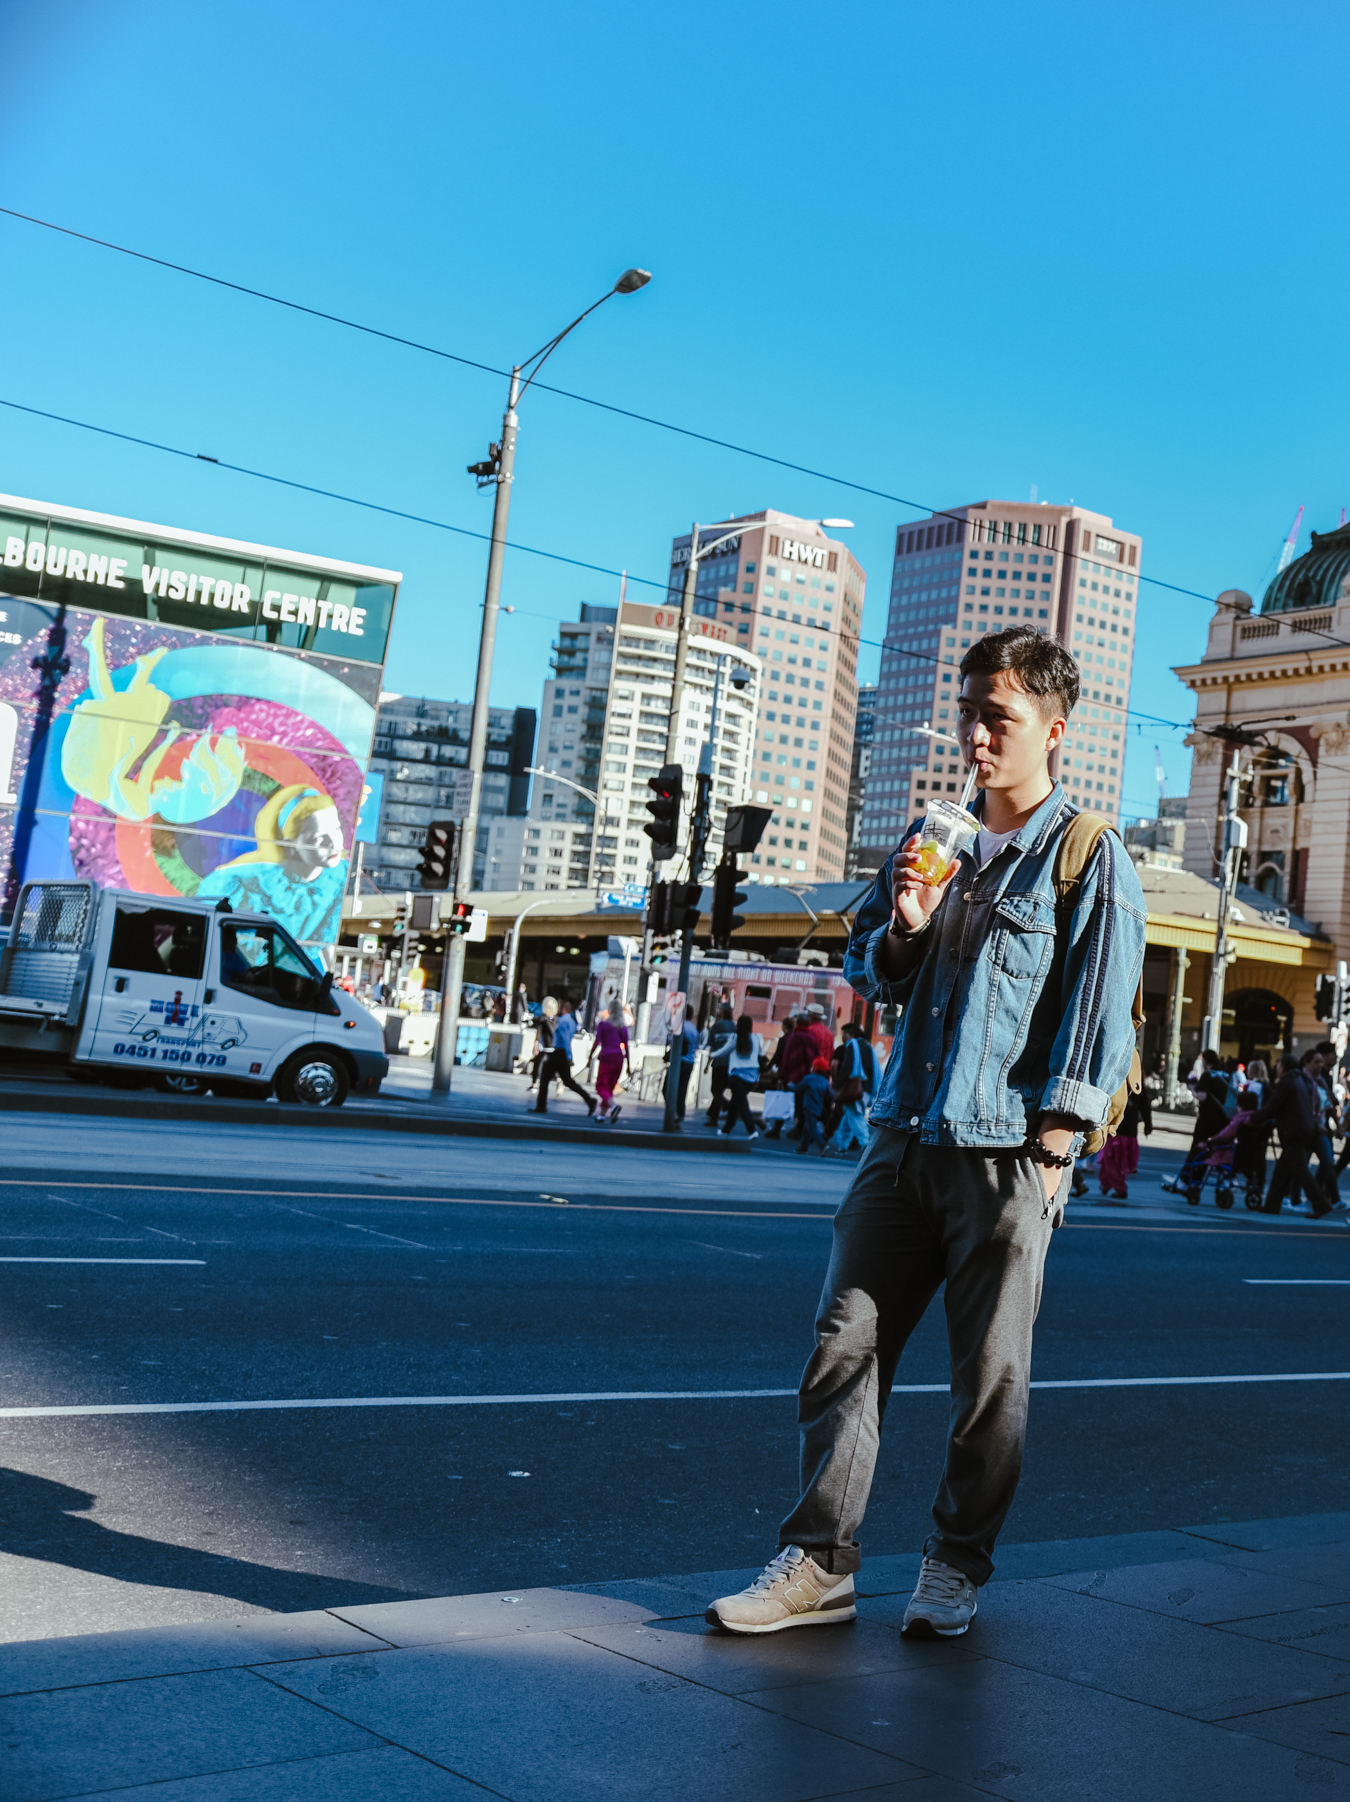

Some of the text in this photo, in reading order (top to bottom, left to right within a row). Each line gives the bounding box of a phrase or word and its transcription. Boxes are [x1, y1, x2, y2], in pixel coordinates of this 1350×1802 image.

[782, 539, 828, 568] HWT
[0, 536, 368, 636] BOURNE VISITOR CENTRE
[702, 622, 728, 642] WEST
[723, 965, 736, 979] ALL
[737, 967, 760, 981] NIGHT
[773, 970, 814, 986] WEEKENDS
[113, 1042, 228, 1067] 0451 150 079
